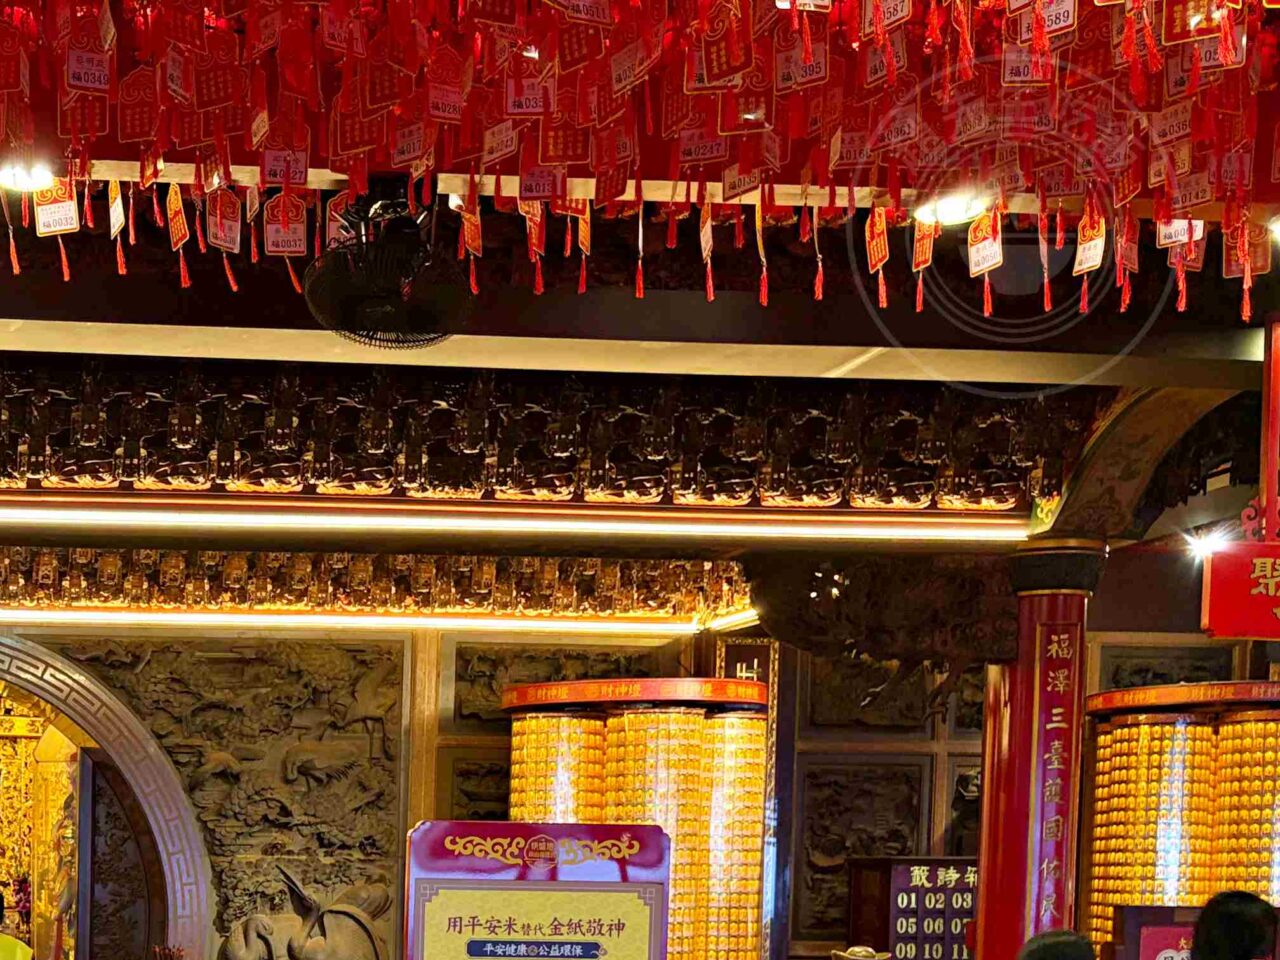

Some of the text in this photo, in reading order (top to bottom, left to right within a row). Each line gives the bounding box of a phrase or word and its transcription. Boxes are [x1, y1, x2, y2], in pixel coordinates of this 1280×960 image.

[897, 892, 973, 909] 01 02 03
[445, 915, 626, 938] 用平安米替代金紙敬神
[896, 917, 918, 935] 05
[923, 917, 945, 934] 06
[482, 943, 529, 957] 平安健康
[895, 942, 970, 960] 09 10 11
